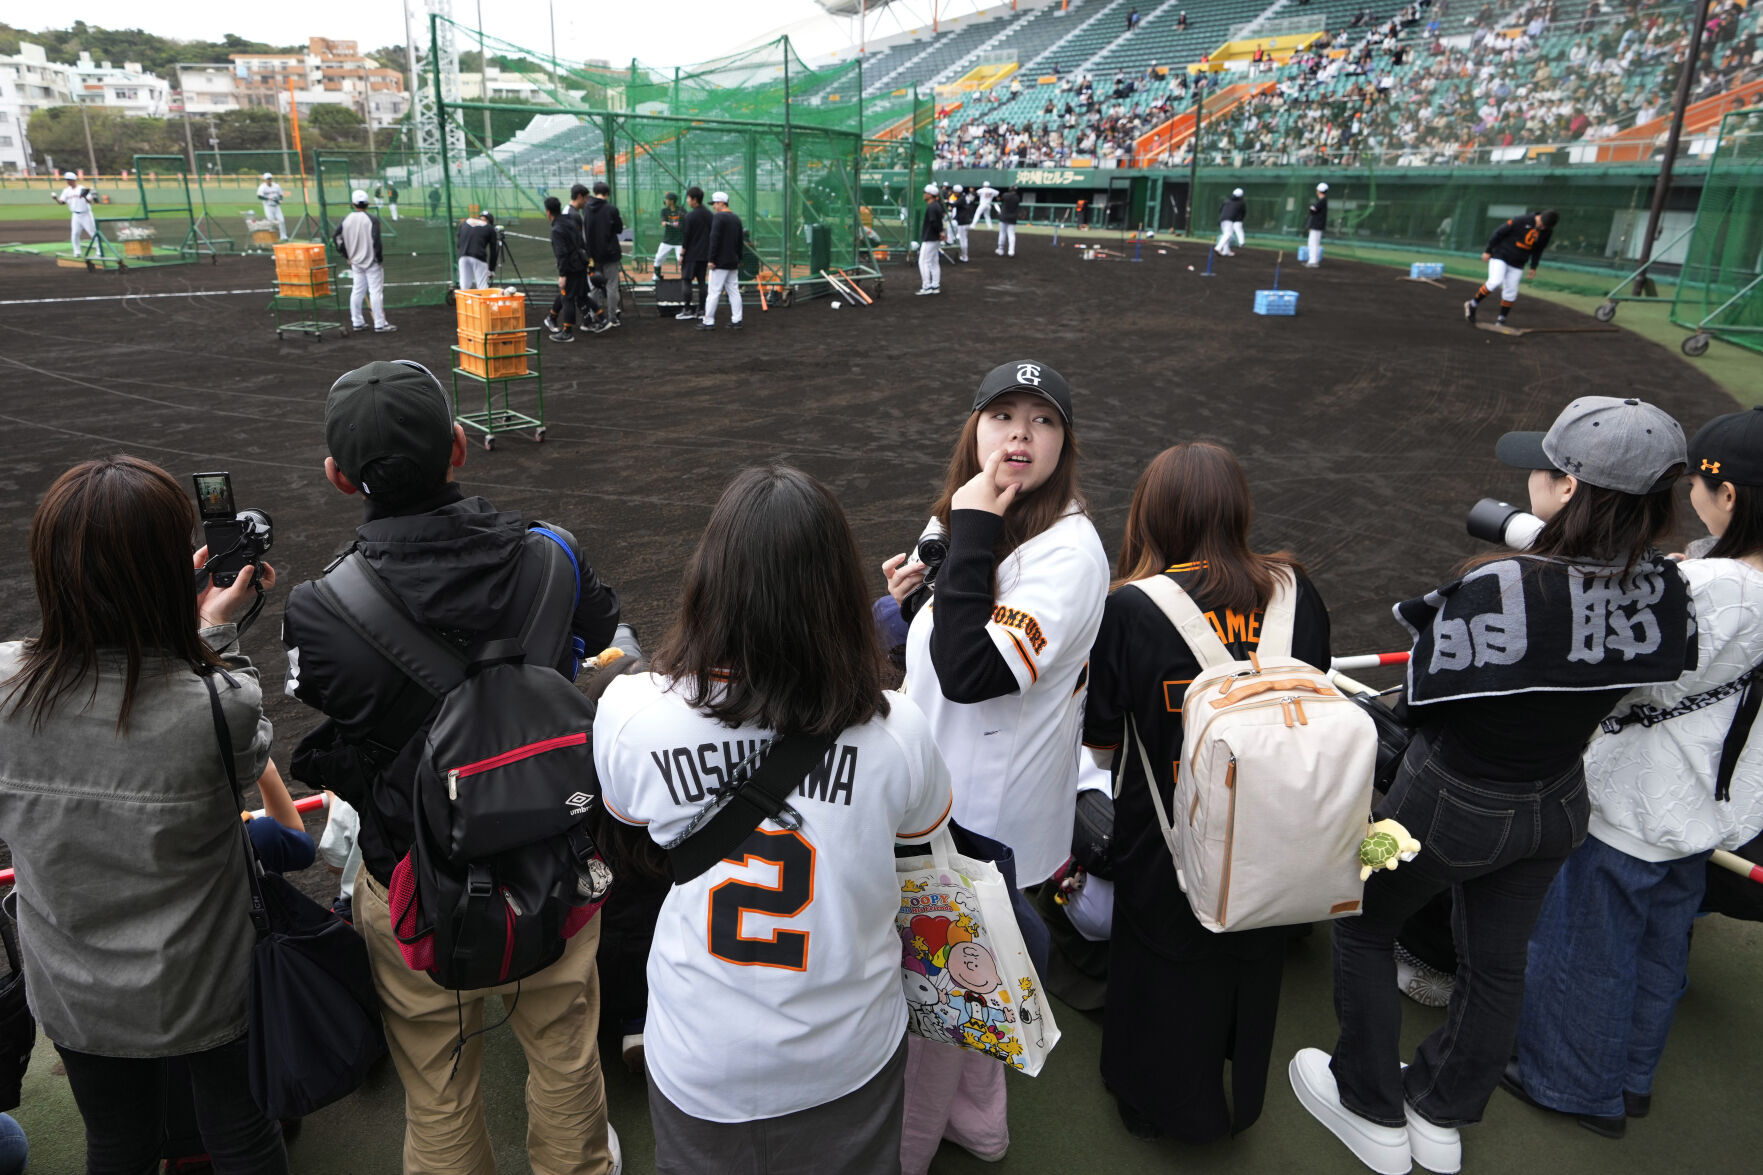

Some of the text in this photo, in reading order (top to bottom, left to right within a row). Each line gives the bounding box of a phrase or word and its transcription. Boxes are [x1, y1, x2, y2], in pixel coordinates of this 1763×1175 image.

[992, 604, 1048, 656] OMIURI
[708, 826, 817, 973] 2
[901, 894, 949, 907] NOOPY
